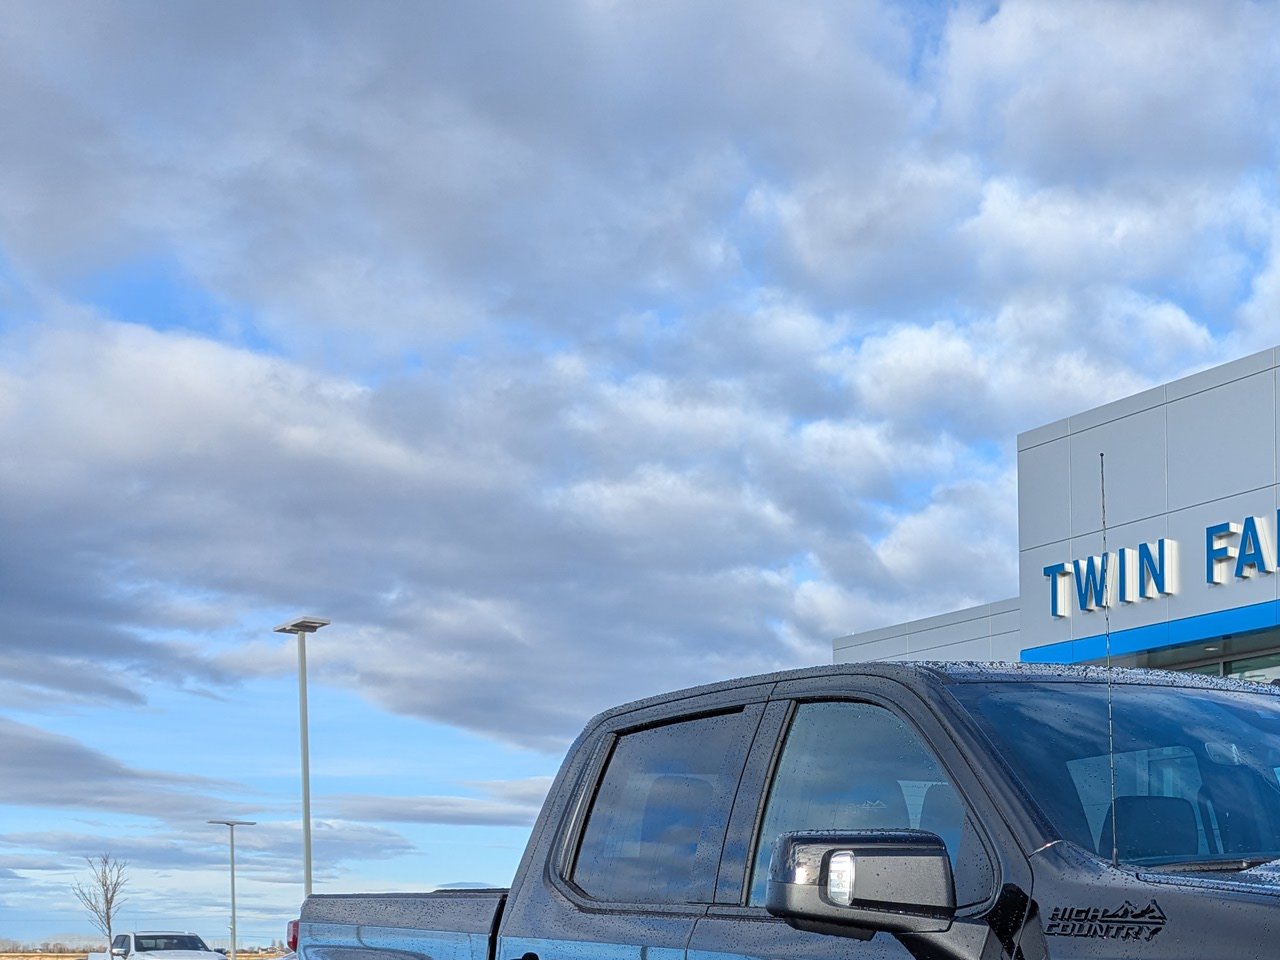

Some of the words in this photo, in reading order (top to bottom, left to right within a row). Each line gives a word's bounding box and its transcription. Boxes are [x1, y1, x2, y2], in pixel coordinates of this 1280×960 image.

[1043, 537, 1171, 618] TWIN
[1047, 906, 1105, 922] HIGH
[1043, 922, 1162, 941] COUNTRY
